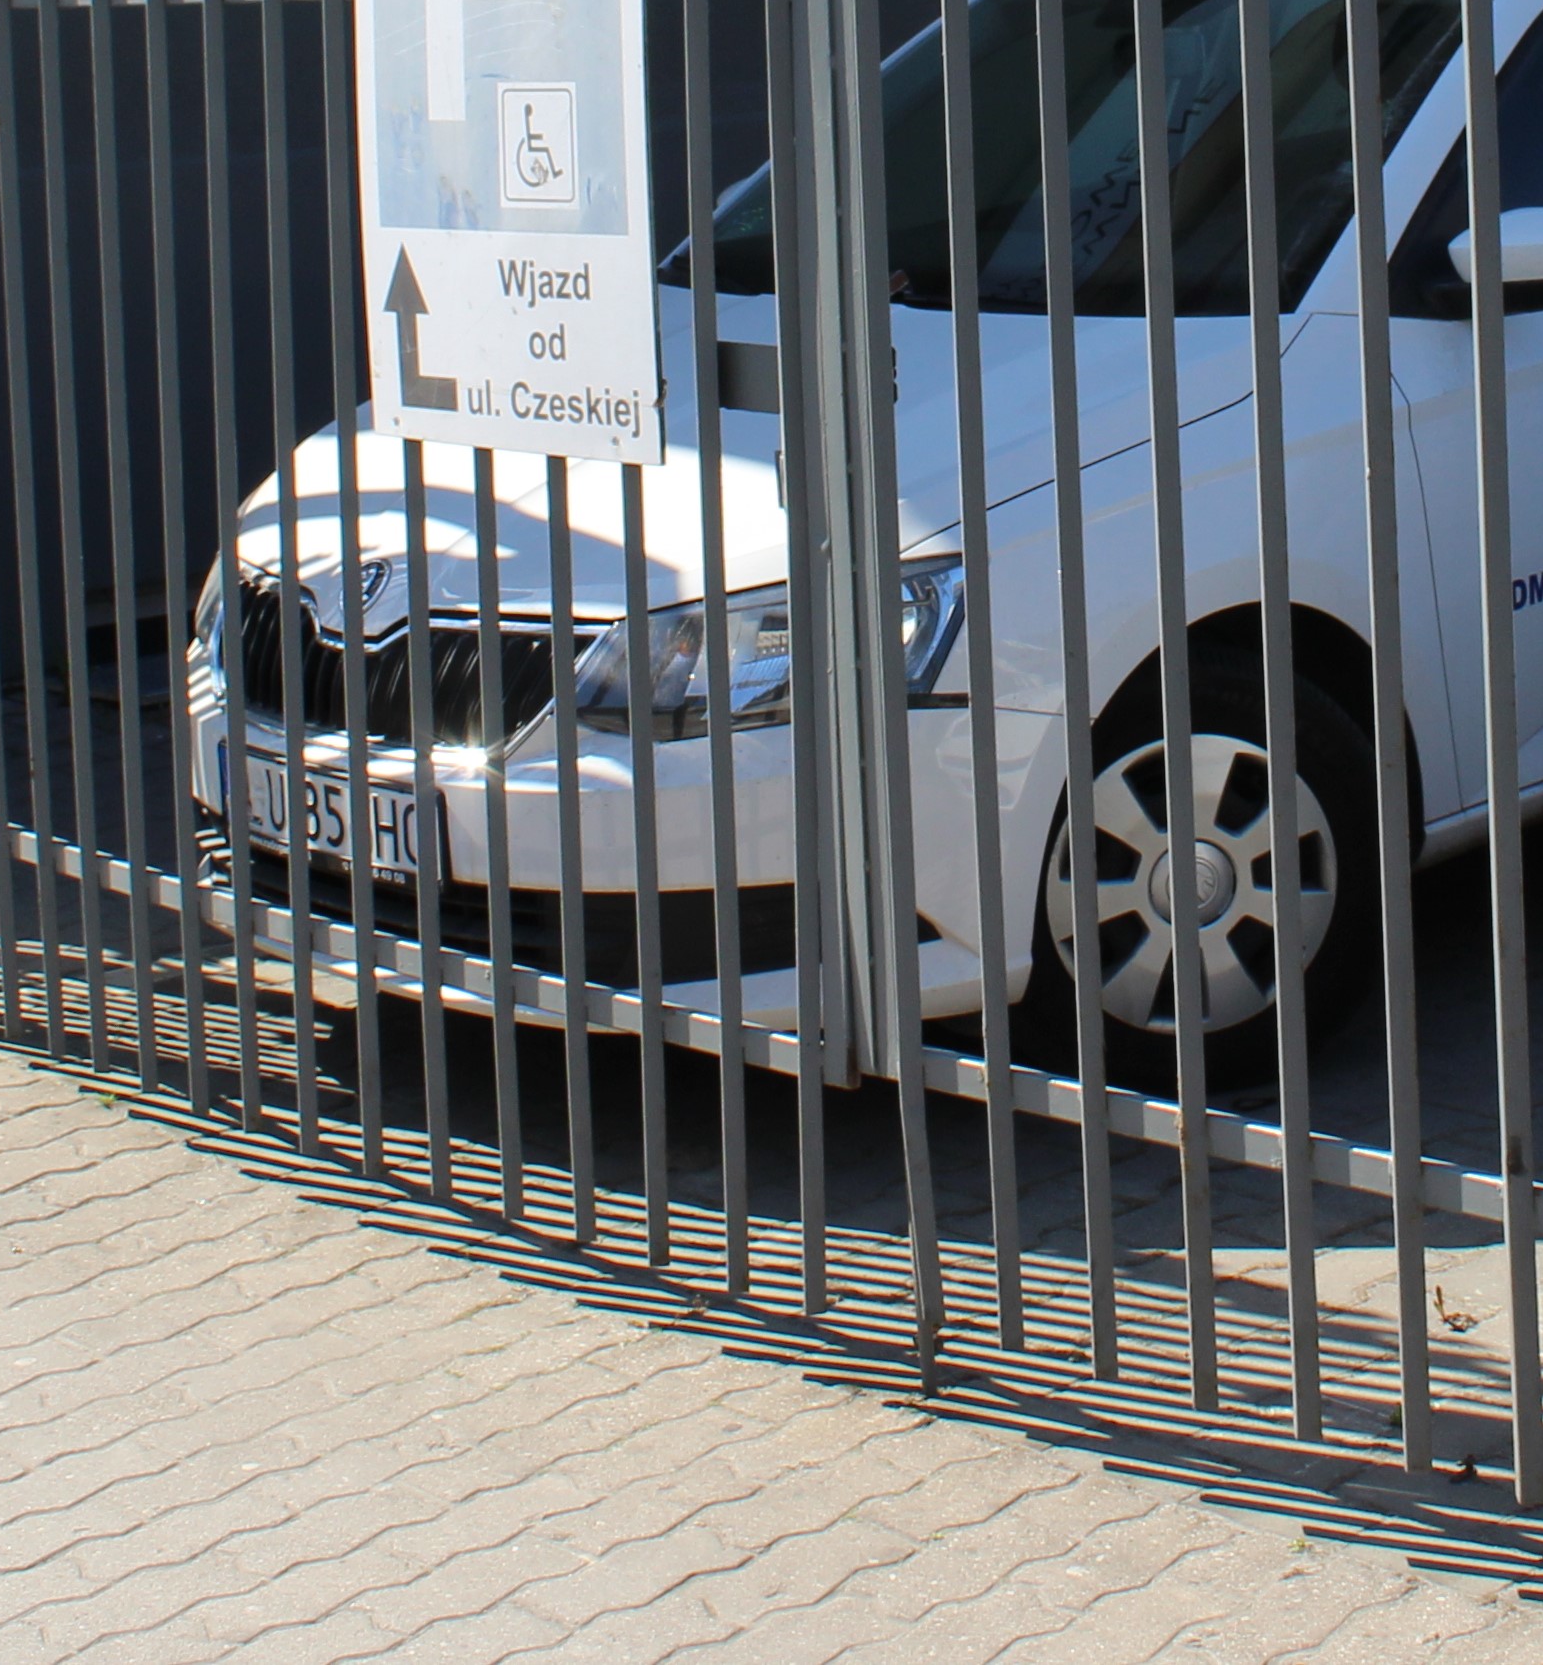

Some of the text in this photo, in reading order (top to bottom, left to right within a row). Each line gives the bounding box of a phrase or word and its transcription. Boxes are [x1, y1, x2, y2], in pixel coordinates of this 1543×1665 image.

[497, 258, 591, 308] Wjazd
[529, 323, 567, 361] od
[467, 379, 641, 439] ul. Czeskiej
